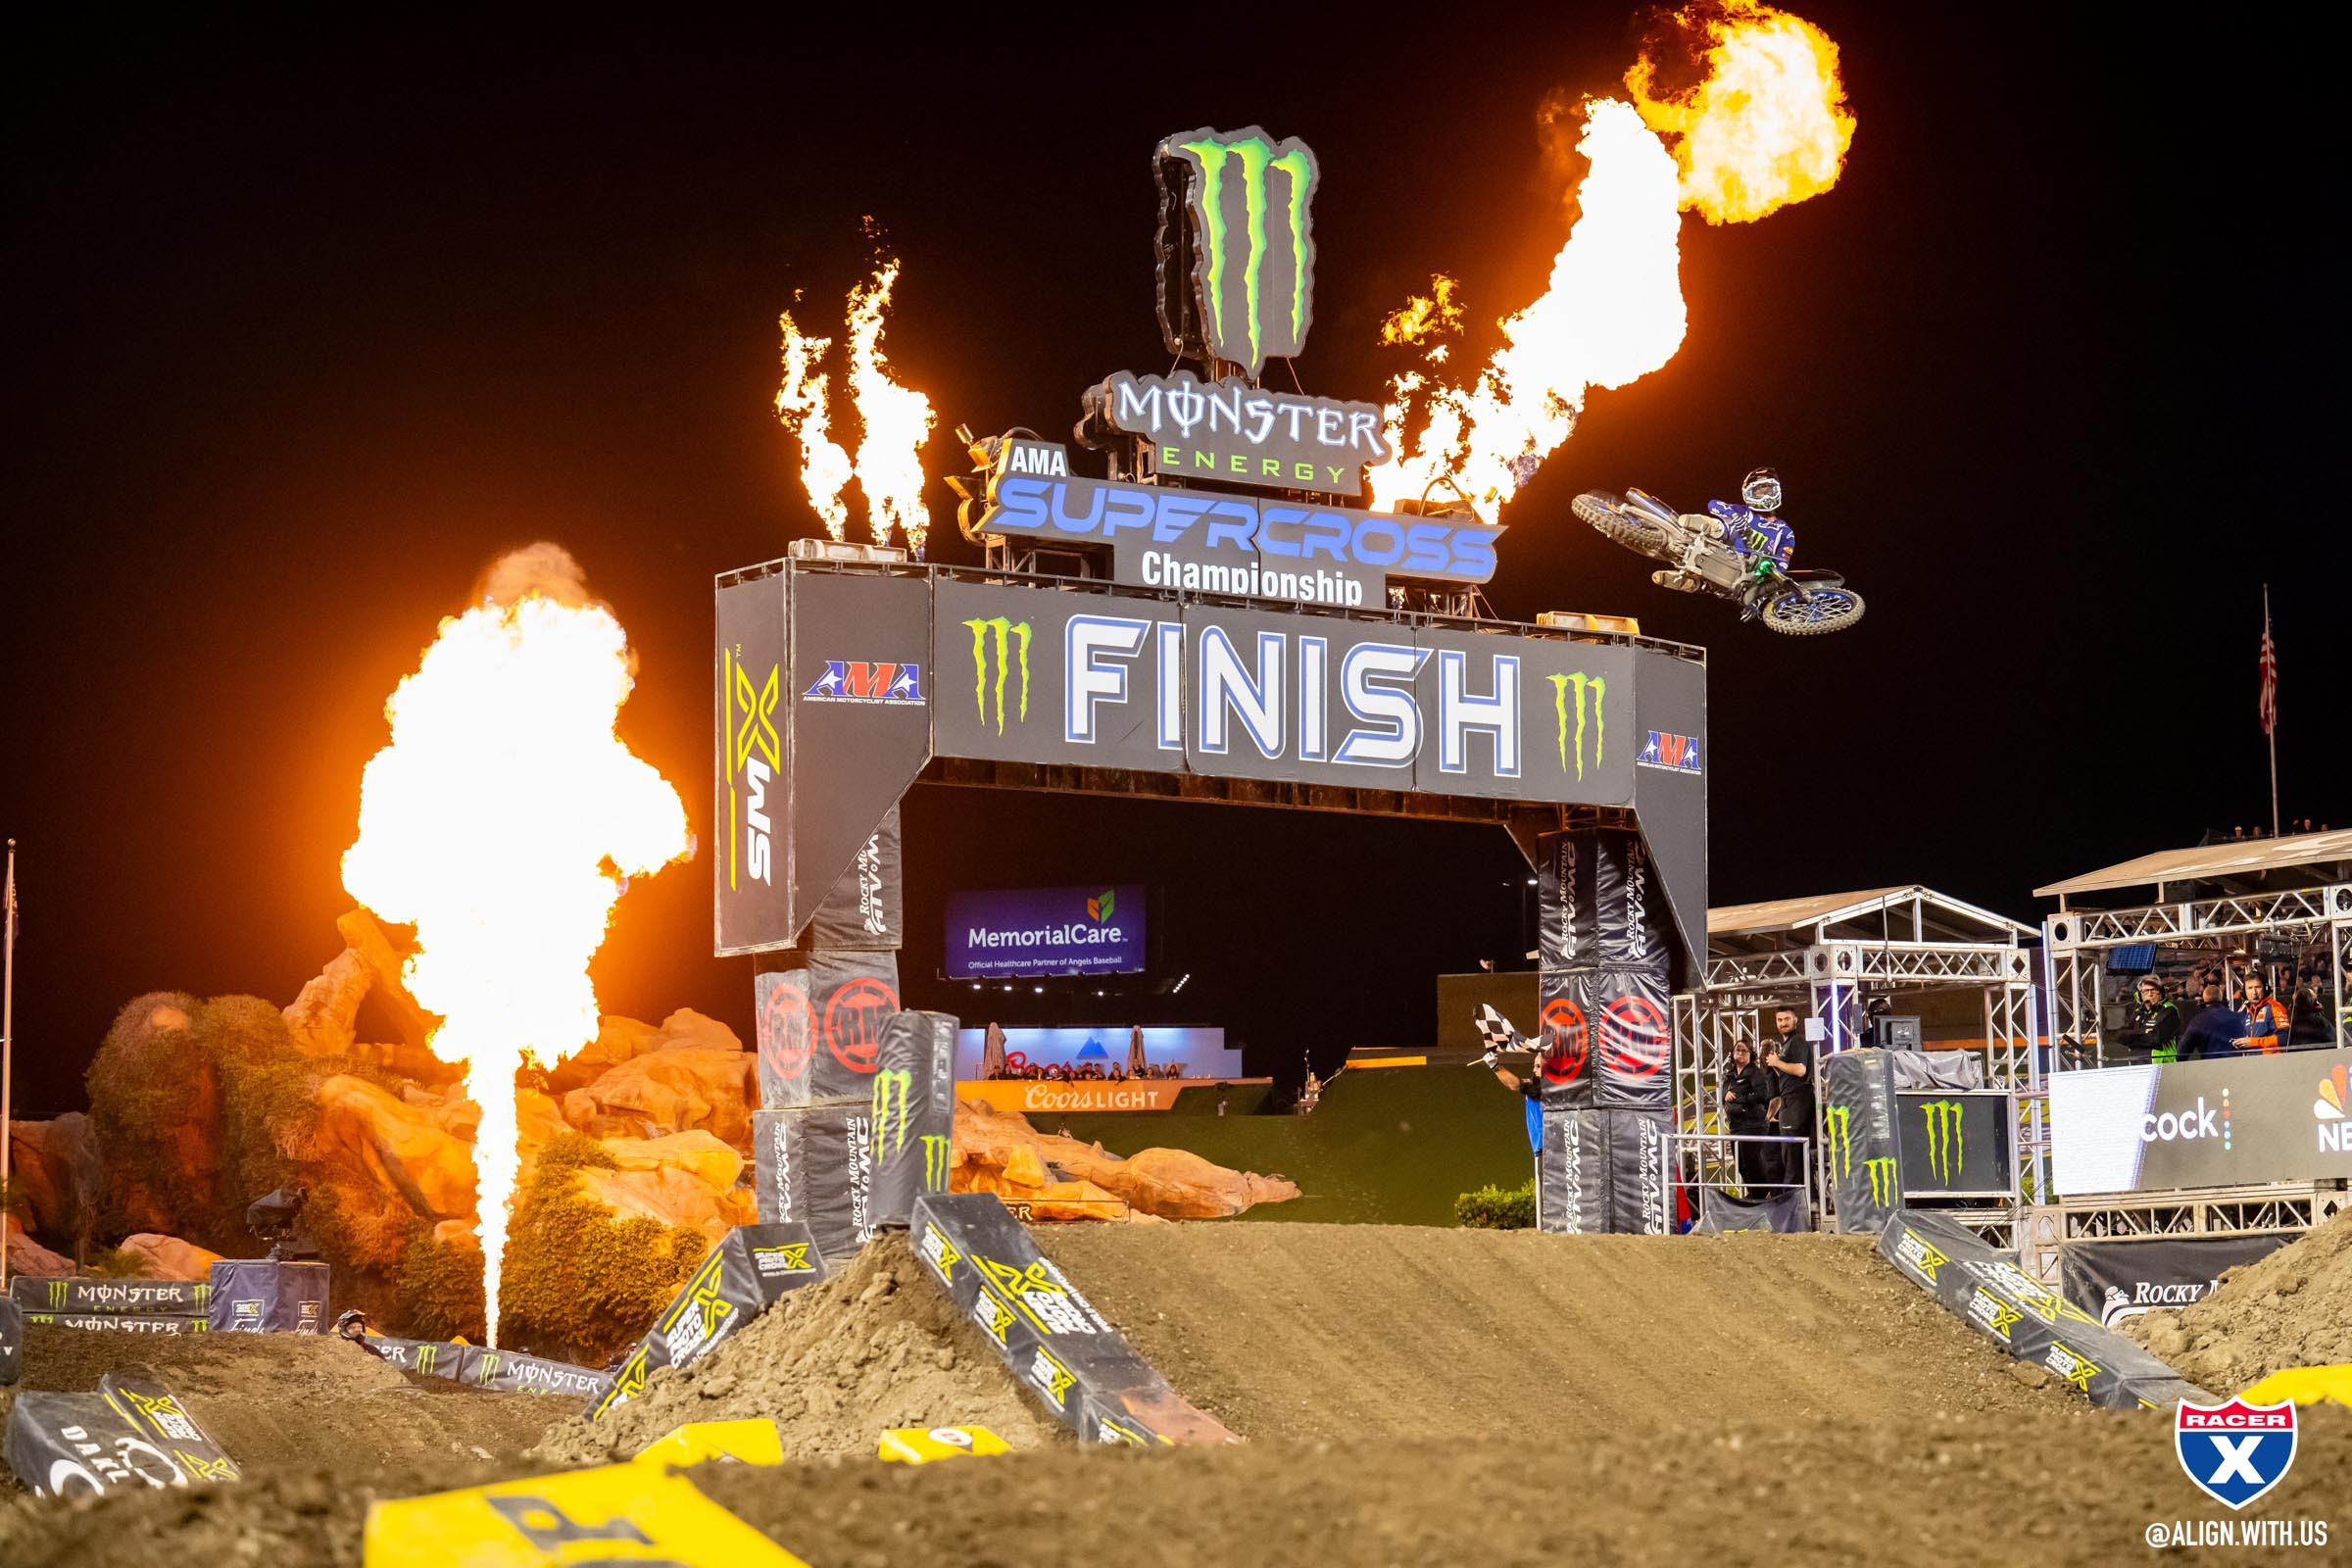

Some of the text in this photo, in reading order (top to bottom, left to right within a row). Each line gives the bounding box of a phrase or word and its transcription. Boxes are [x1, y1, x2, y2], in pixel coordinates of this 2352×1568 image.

[1010, 445, 1067, 477] AMA
[1162, 447, 1346, 484] ENERGY
[993, 477, 1509, 577] SUPERCROSS
[1142, 551, 1362, 607] Championship
[802, 661, 926, 699] AMA
[1065, 614, 1521, 777] FINISH
[1637, 730, 1701, 770] AMA
[859, 873, 870, 915] ROCKY
[968, 924, 1122, 948] MemorialCare
[1627, 902, 1636, 940] ROCKY
[994, 959, 1031, 968] Healthcare
[1068, 957, 1092, 967] Angels
[1025, 1084, 1159, 1109] Coors LIGHT
[1564, 1119, 1573, 1181] MOUNTAIN
[1639, 1118, 1651, 1219] ROCKY MOUNTAIN
[846, 1117, 862, 1227] ROCKY MOUNTAIN
[2133, 1282, 2204, 1303] ROCKY
